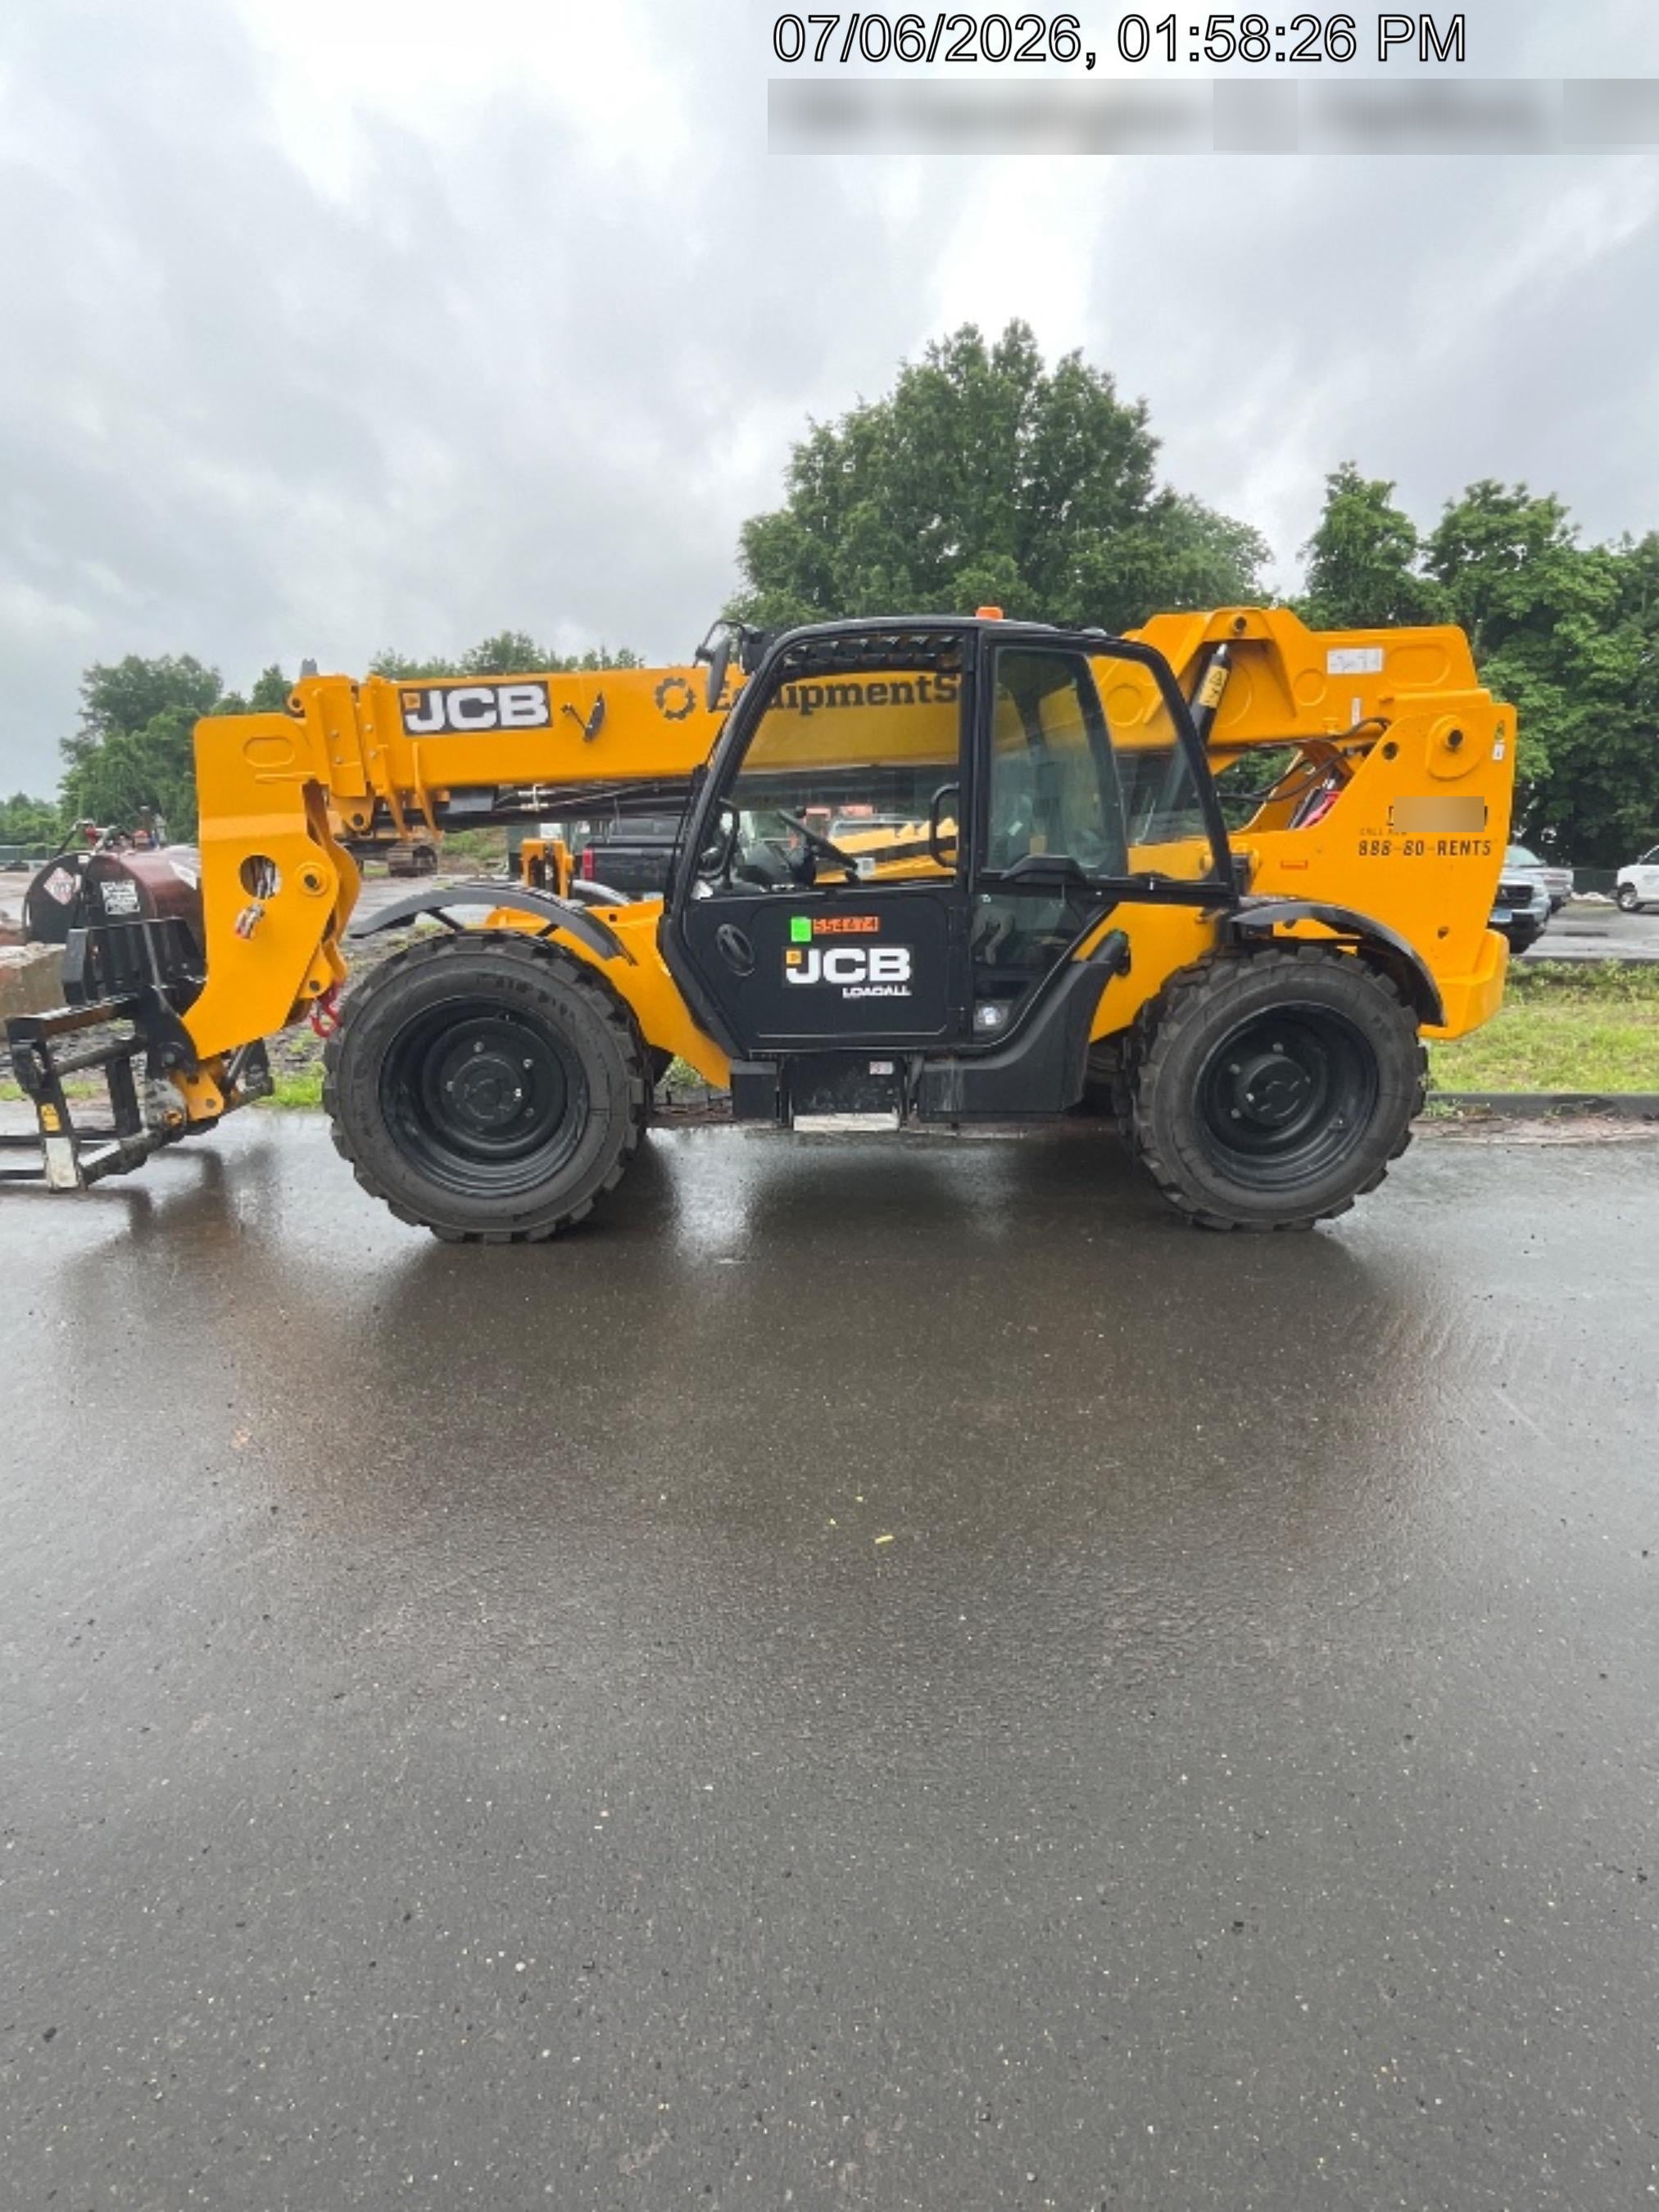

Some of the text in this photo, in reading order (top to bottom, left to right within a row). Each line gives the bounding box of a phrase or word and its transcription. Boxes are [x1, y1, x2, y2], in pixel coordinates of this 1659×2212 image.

[402, 685, 549, 732] JCB
[786, 948, 911, 983] JCB
[842, 986, 912, 999] LOADALL
